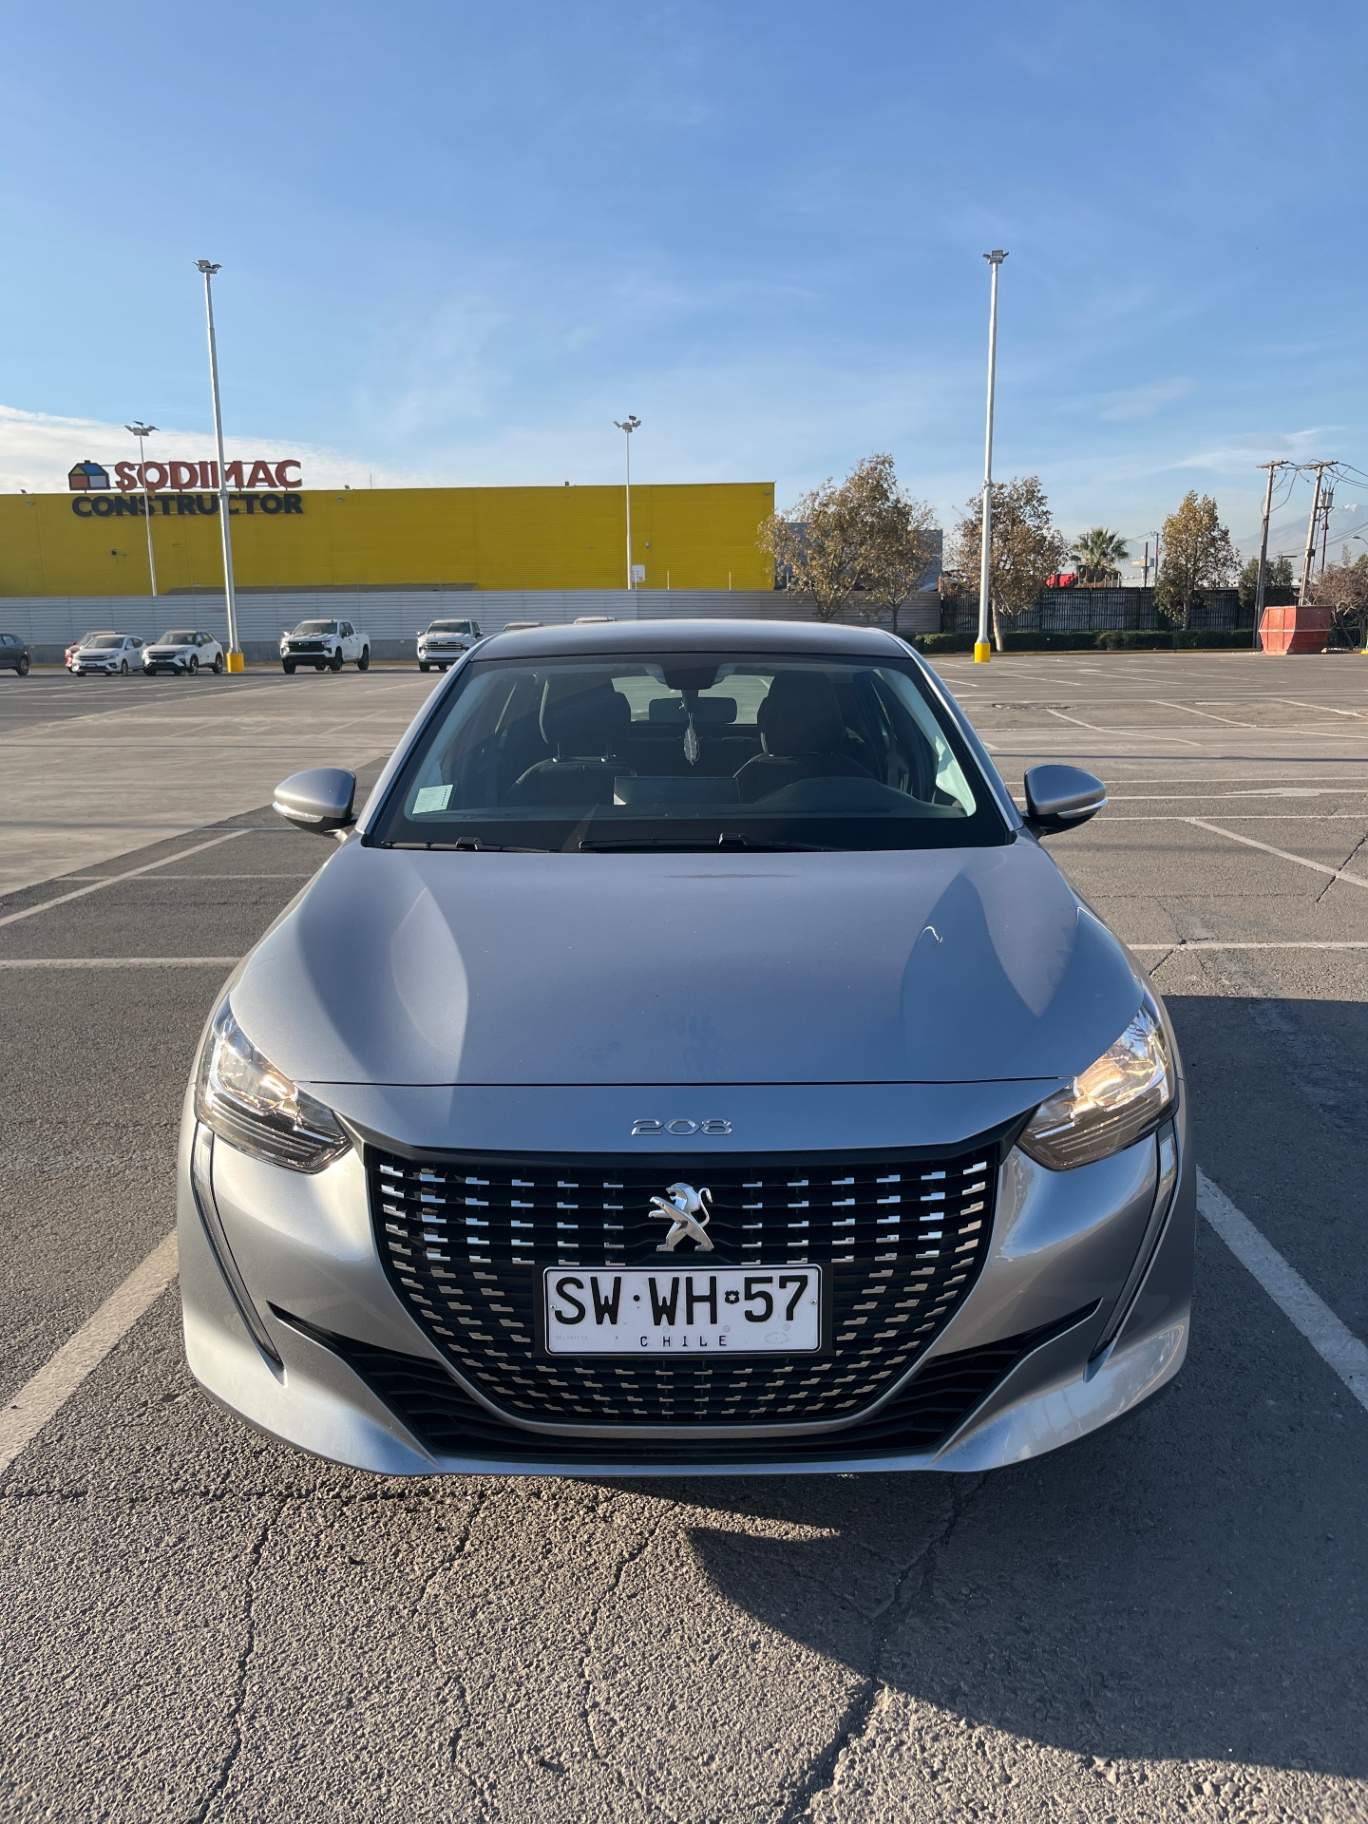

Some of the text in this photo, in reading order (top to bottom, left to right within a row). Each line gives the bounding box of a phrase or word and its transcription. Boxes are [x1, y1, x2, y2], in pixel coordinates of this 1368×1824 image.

[114, 459, 302, 491] SODIMAC
[72, 493, 303, 517] CONSTRUCTOR
[631, 1119, 733, 1136] 208
[640, 1335, 727, 1347] CHILE
